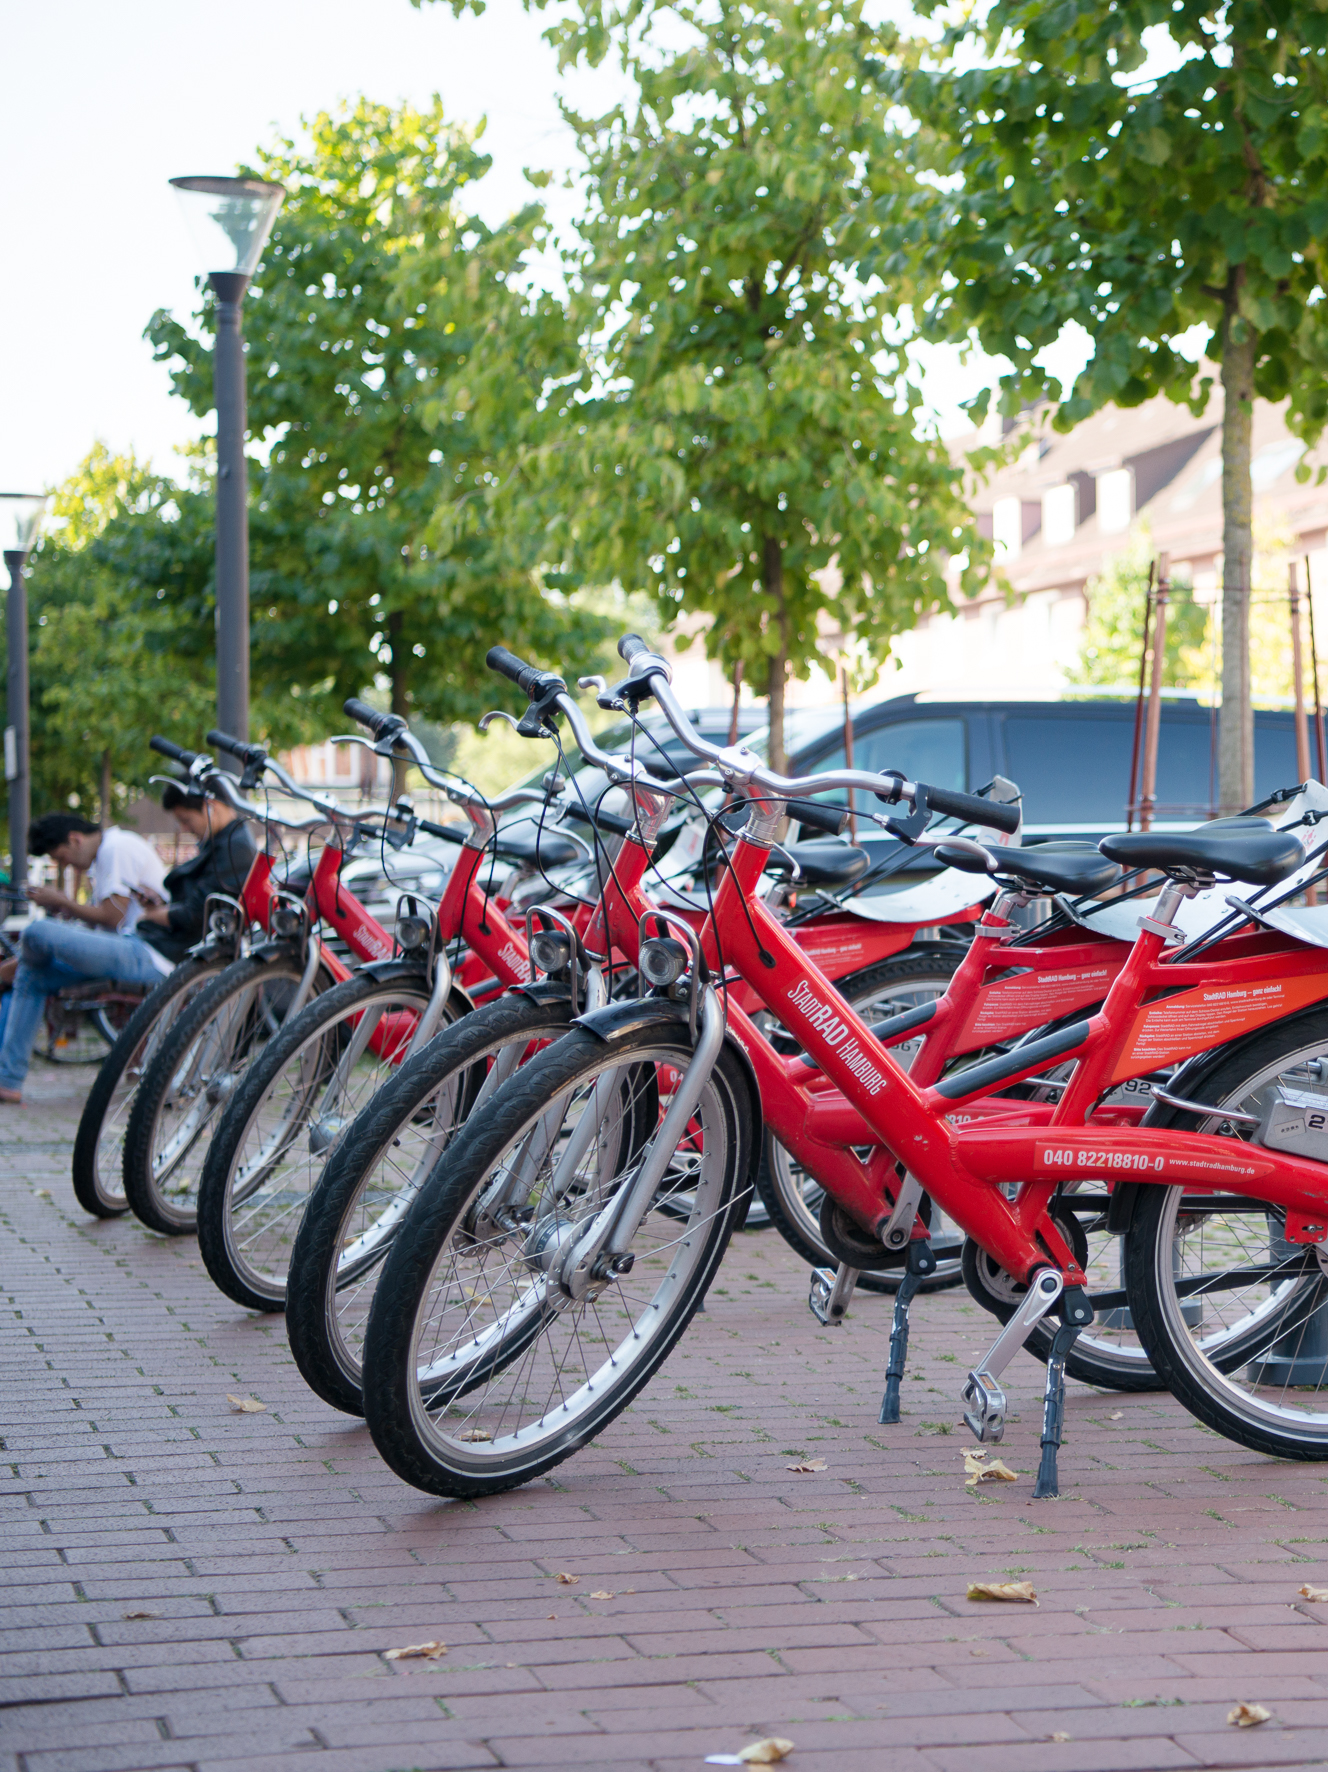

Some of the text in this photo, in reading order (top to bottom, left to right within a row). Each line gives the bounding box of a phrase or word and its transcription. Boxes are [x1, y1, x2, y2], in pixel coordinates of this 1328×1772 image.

[1043, 1149, 1255, 1175] 040 82218810-0 www.stadtradhamburg.de
